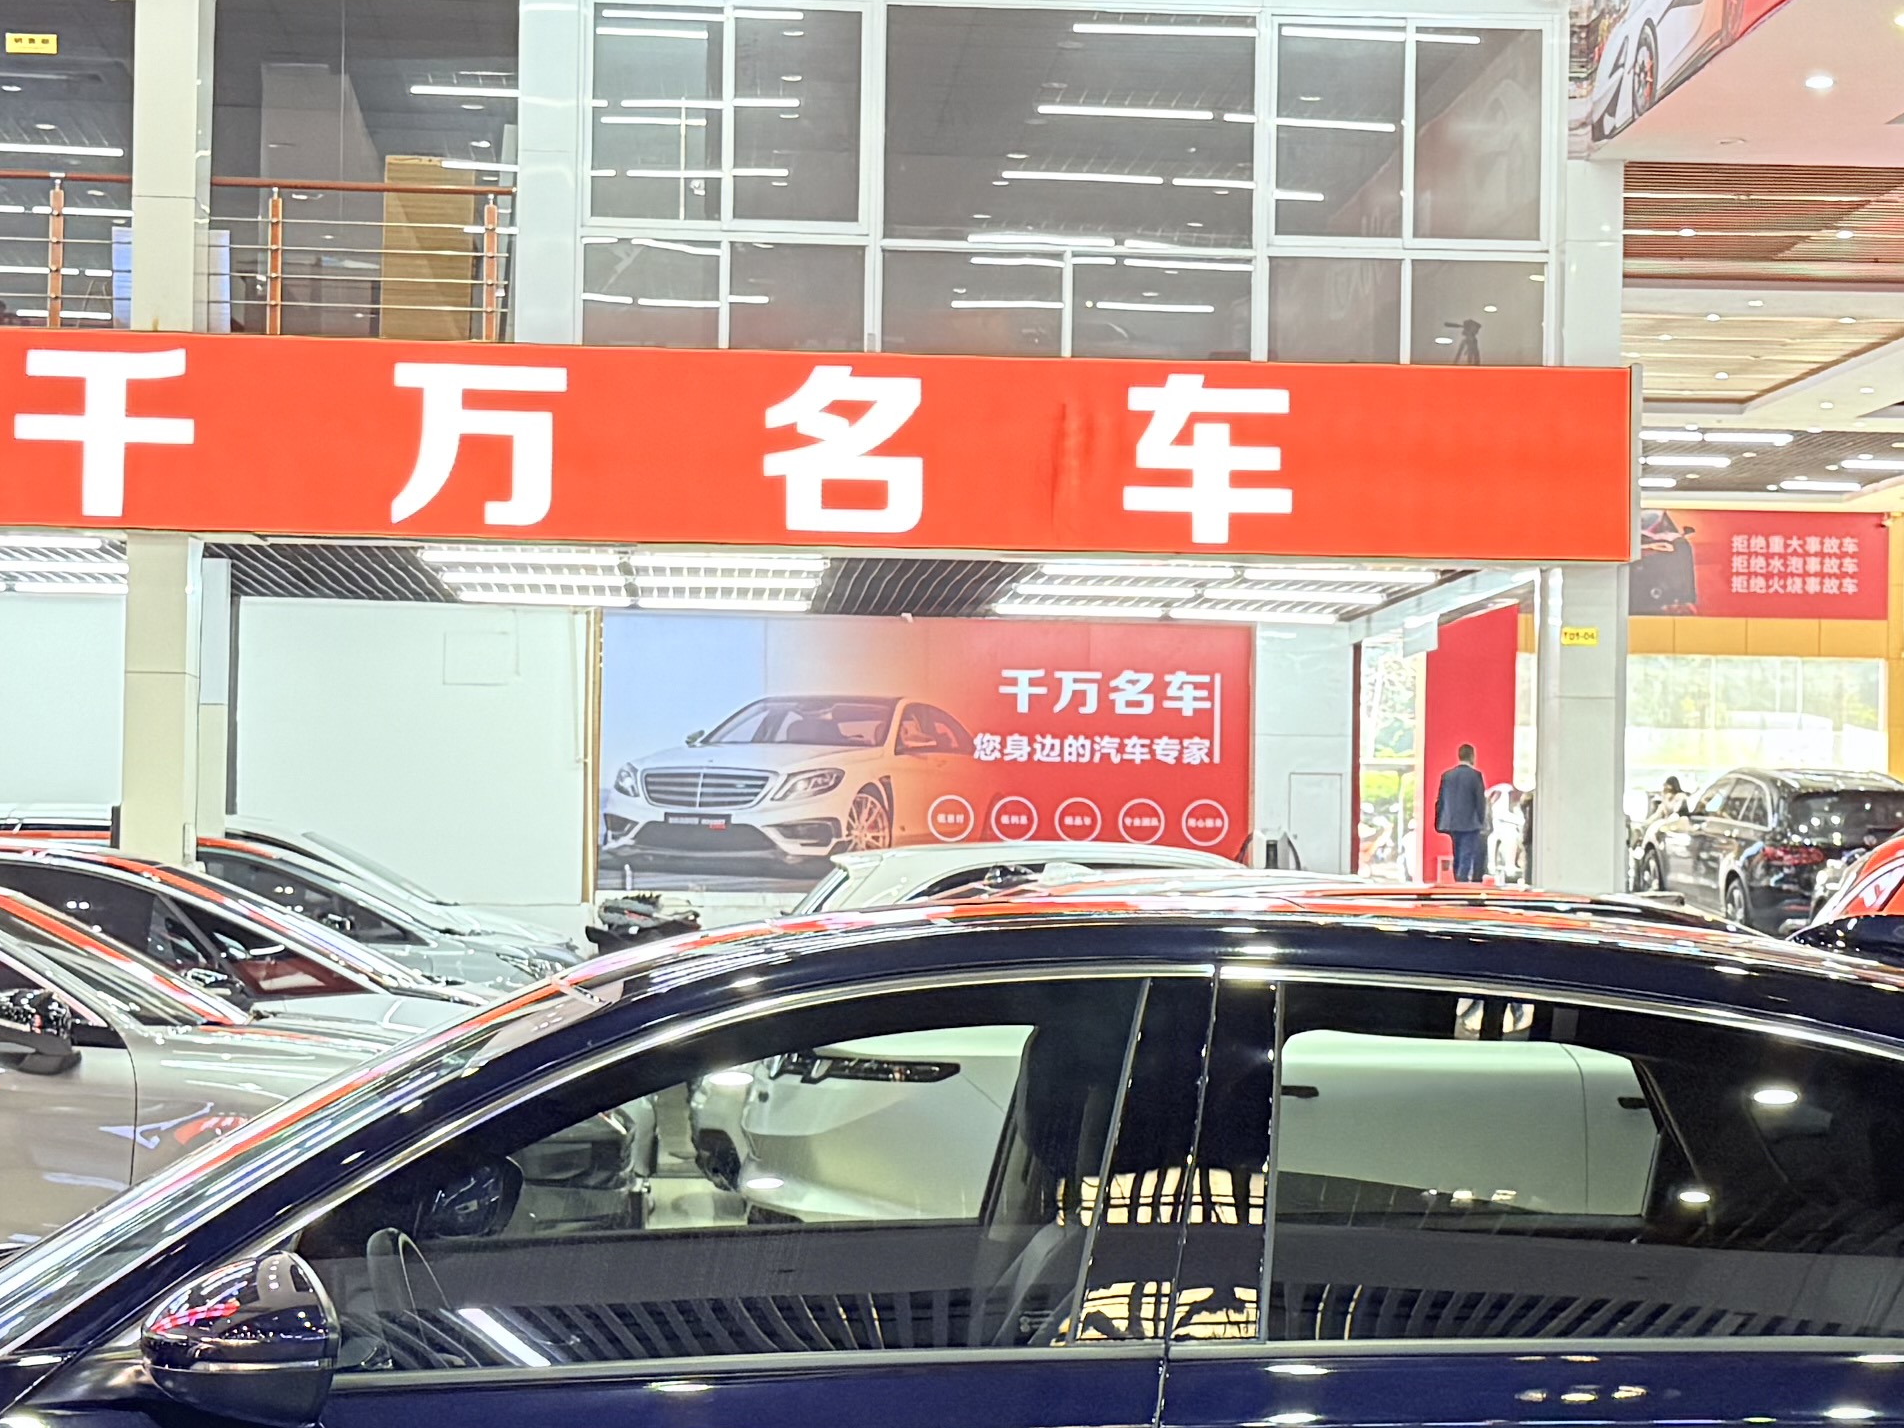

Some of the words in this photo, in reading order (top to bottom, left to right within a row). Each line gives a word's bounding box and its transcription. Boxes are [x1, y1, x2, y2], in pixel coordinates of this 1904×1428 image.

[14, 349, 1293, 545] 千万名车
[1731, 534, 1859, 554] 拒绝重大事故车
[1731, 554, 1859, 575] 拒绝水泡事故车
[1731, 574, 1859, 595] 拒绝火烧事故车
[998, 668, 1213, 717] 千万名车
[973, 732, 1212, 766] 您身边的汽车专家
